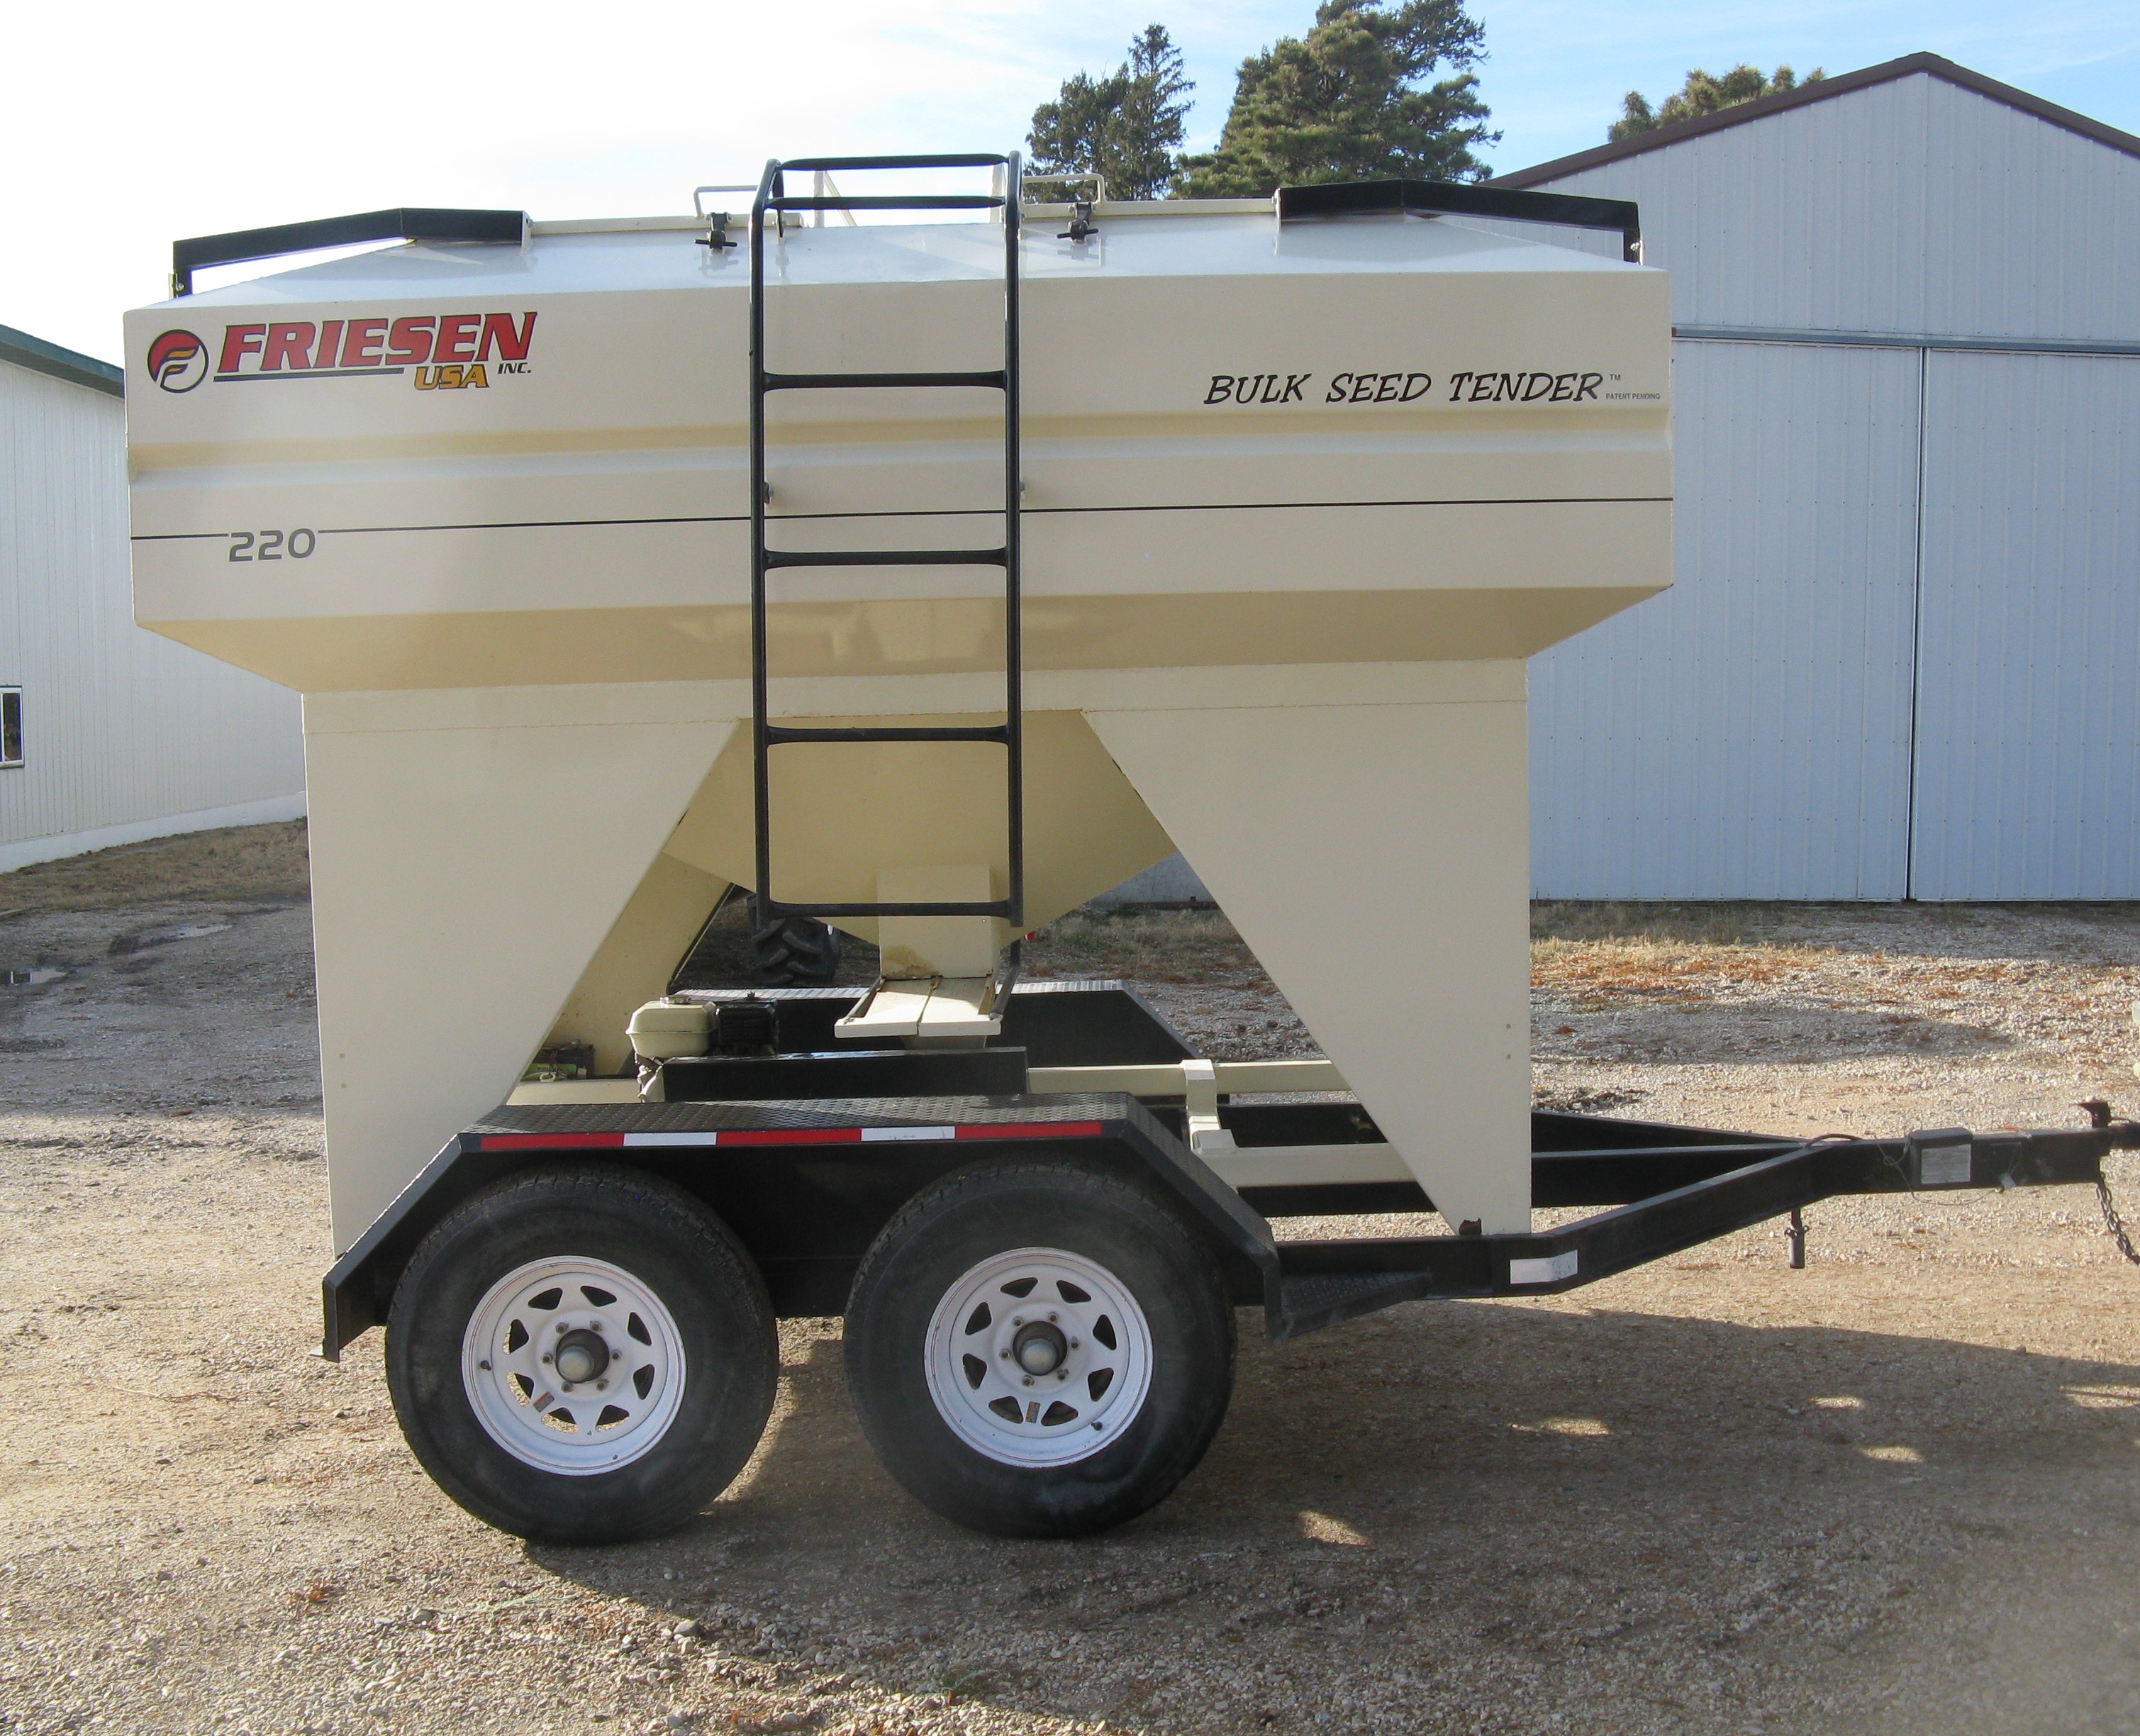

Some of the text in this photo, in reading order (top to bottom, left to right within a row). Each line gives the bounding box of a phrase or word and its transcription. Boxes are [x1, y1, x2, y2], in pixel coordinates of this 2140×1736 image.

[217, 311, 537, 373] FRIESEN
[414, 362, 532, 391] USA INC.
[1203, 373, 1312, 404] BULK
[1325, 373, 1432, 403] SEED
[1449, 372, 1603, 402] TENDER
[228, 528, 316, 562] 220
